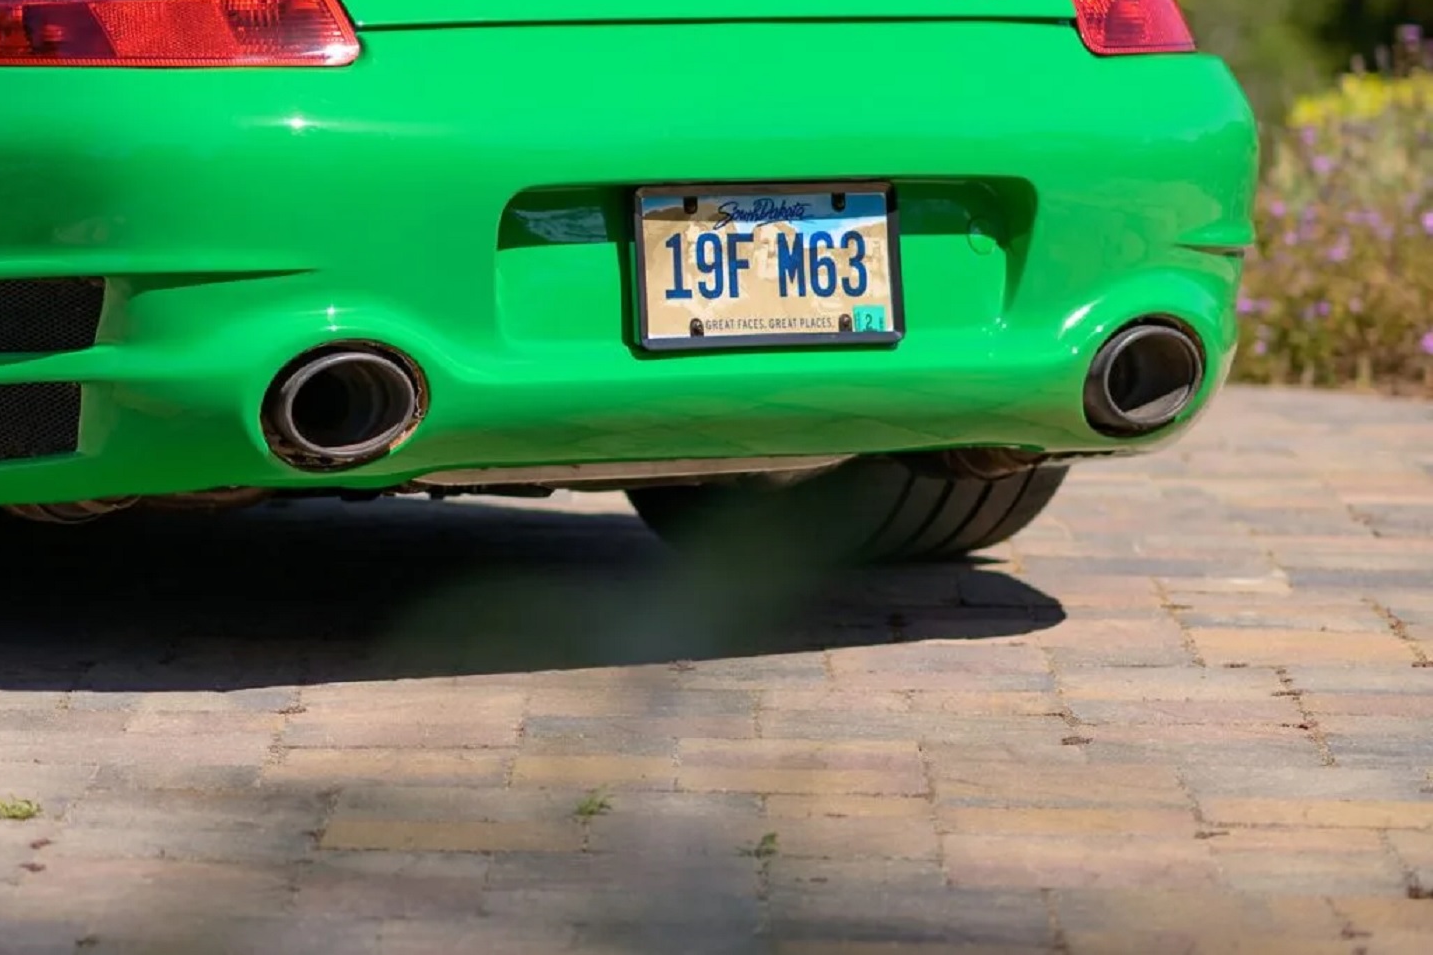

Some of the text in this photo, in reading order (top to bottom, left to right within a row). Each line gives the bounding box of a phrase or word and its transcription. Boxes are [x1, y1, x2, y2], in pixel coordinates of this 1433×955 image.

[753, 198, 812, 227] Dakota
[665, 230, 868, 300] 19F M63
[705, 319, 736, 330] GREAT
[768, 317, 797, 329] GREAT
